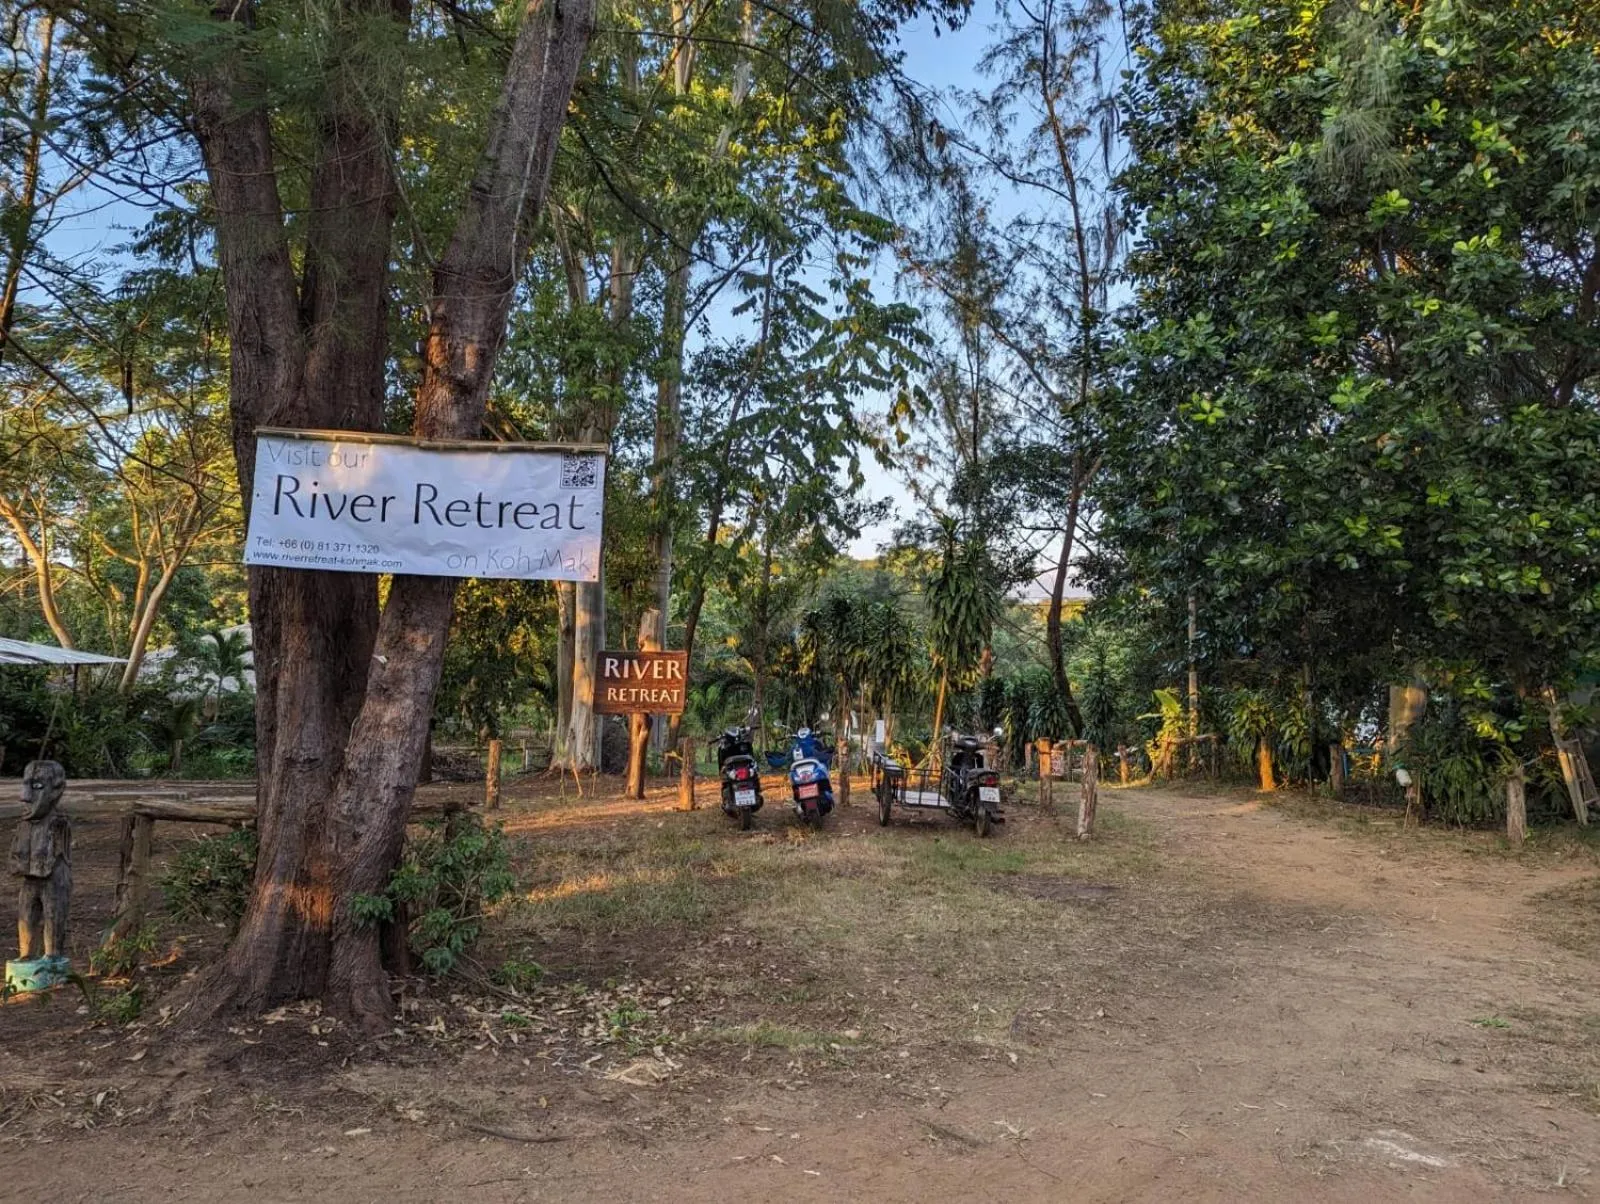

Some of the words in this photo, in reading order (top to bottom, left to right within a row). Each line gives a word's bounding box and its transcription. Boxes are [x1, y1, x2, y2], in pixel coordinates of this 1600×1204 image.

[266, 440, 321, 467] Visit
[328, 451, 369, 468] our
[273, 474, 396, 523] River
[413, 483, 586, 530] Retreat
[279, 538, 297, 549] +66
[300, 539, 315, 551] (0)
[317, 541, 330, 551] 81
[333, 542, 351, 553] 371
[446, 553, 478, 569] on
[486, 547, 530, 570] Koh
[539, 548, 591, 573] Mak
[604, 657, 683, 680] RIVER
[607, 687, 681, 704] RETREAT
